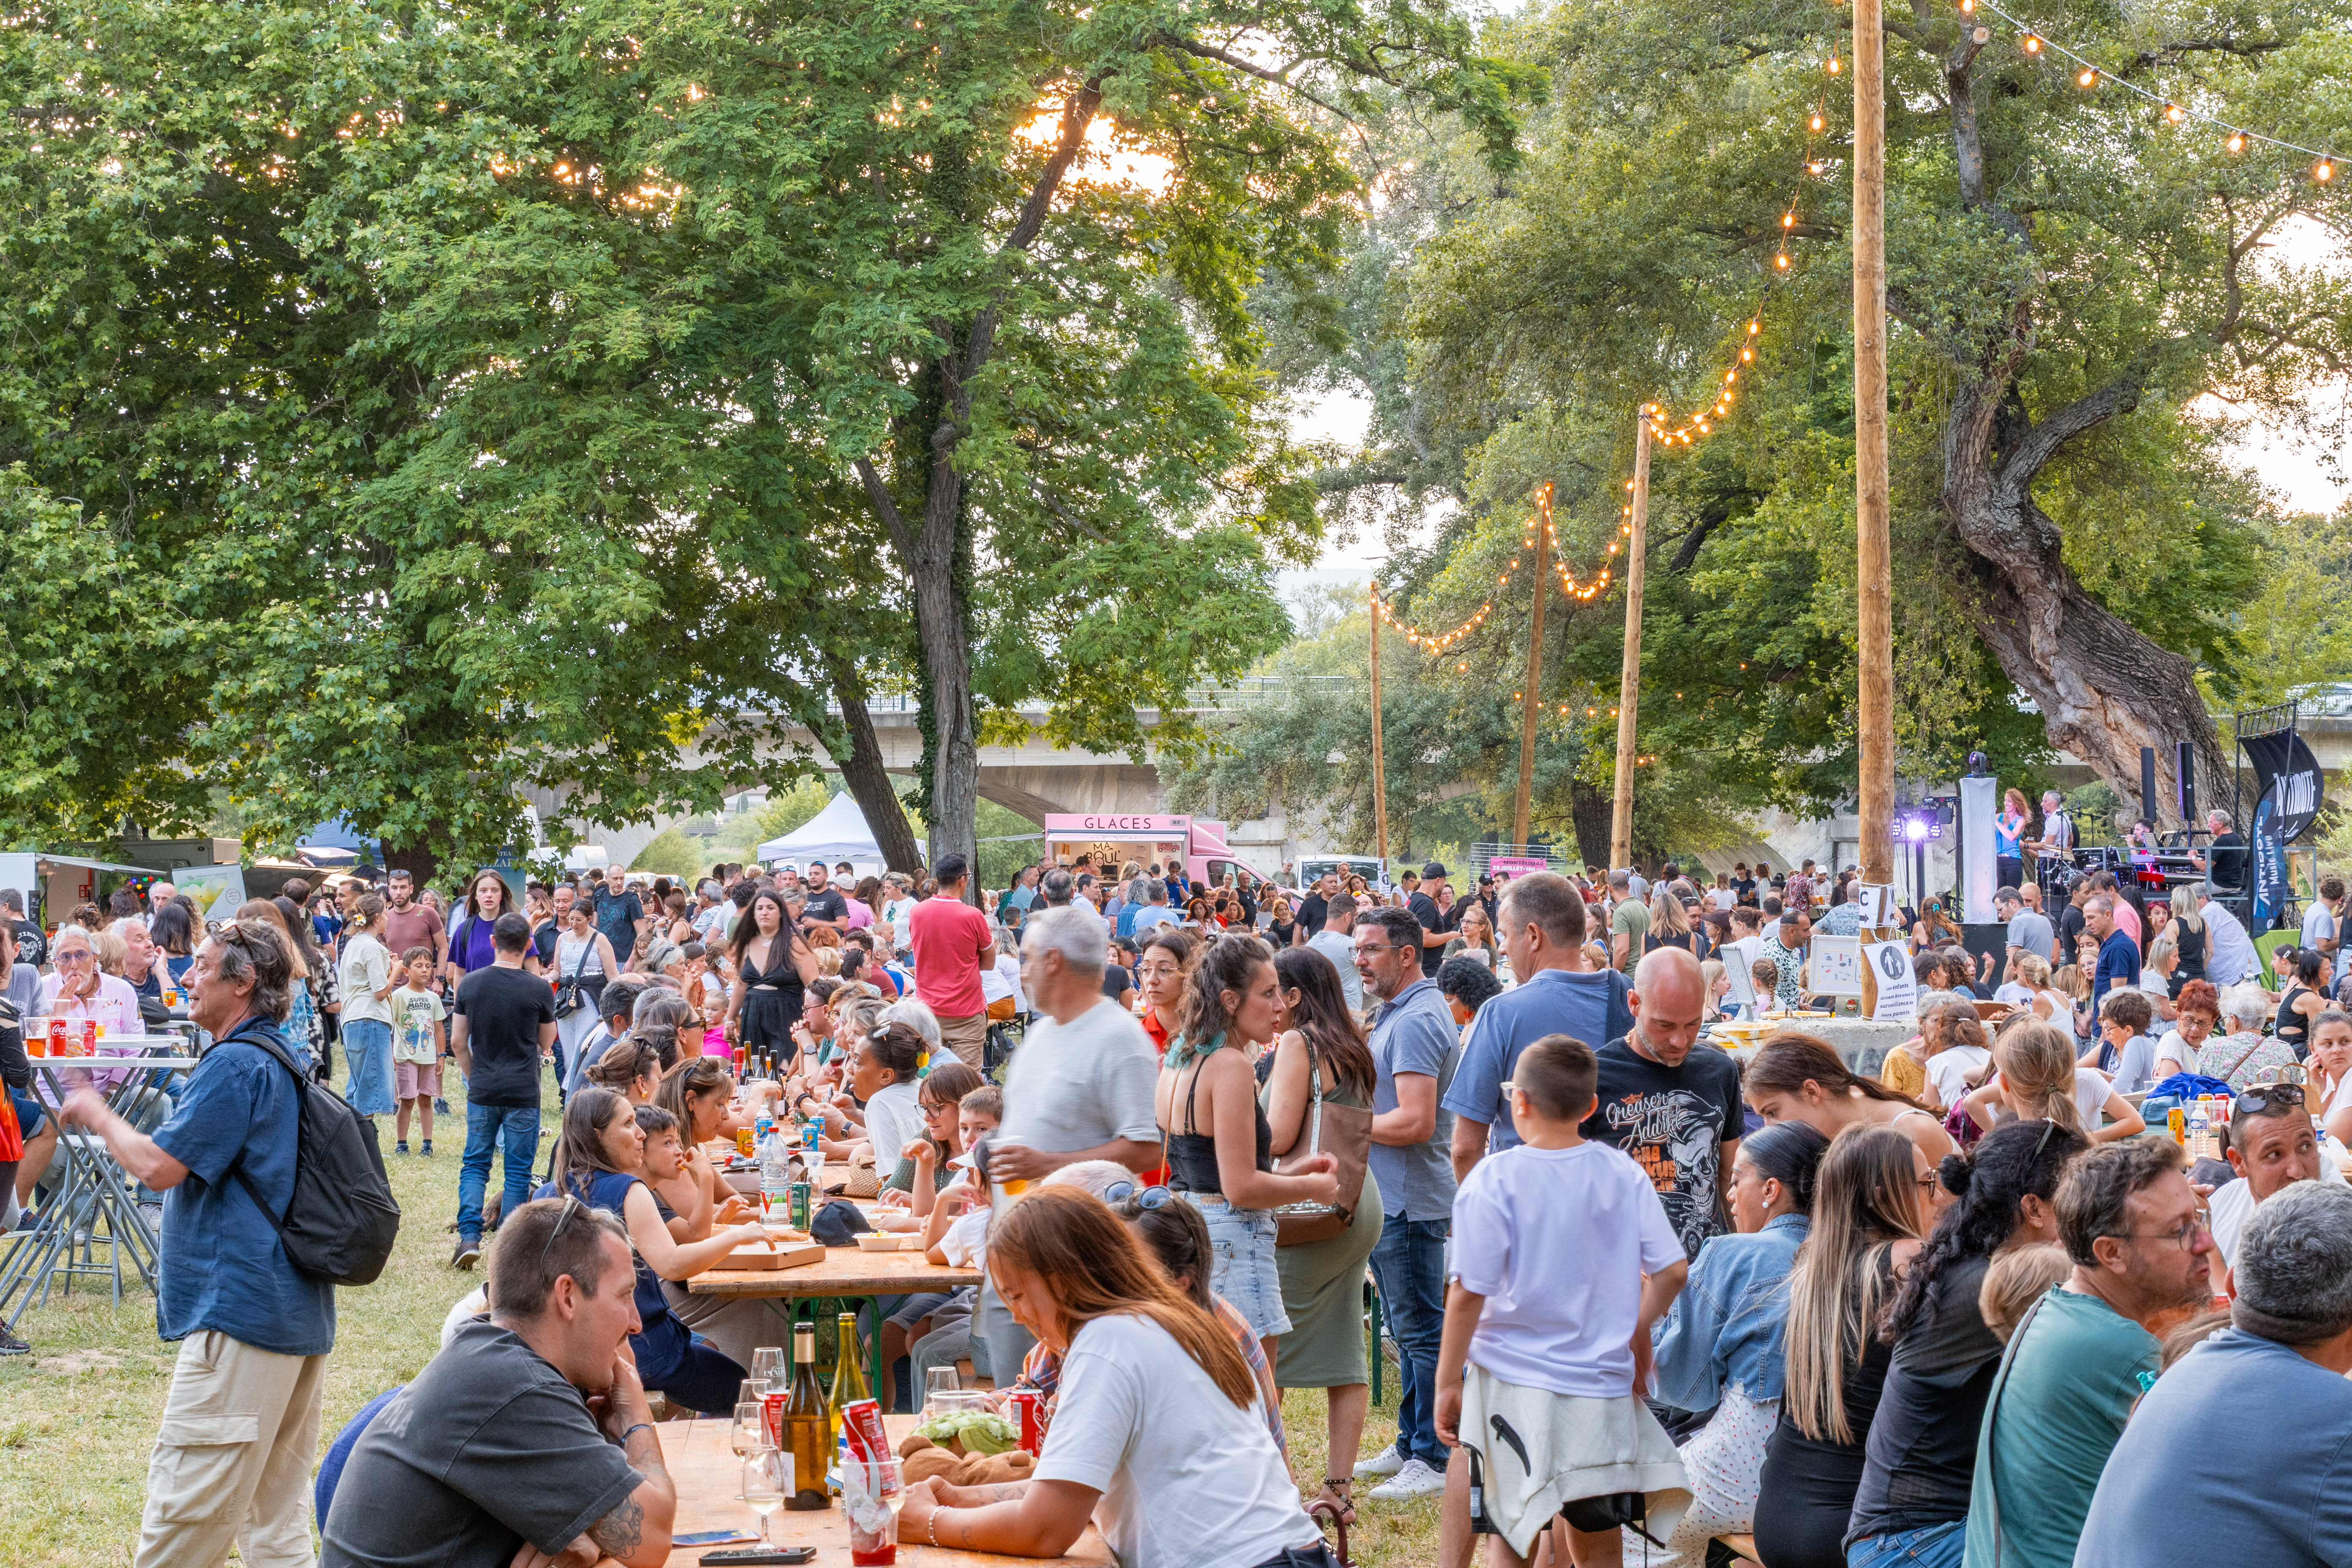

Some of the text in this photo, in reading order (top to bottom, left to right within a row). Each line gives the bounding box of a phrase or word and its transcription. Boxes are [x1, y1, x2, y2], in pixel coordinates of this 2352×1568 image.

[1084, 817, 1151, 829] GLACES
[1093, 842, 1113, 852] MA
[2264, 835, 2279, 885] Music Live
[1606, 1092, 1669, 1130] Greaser
